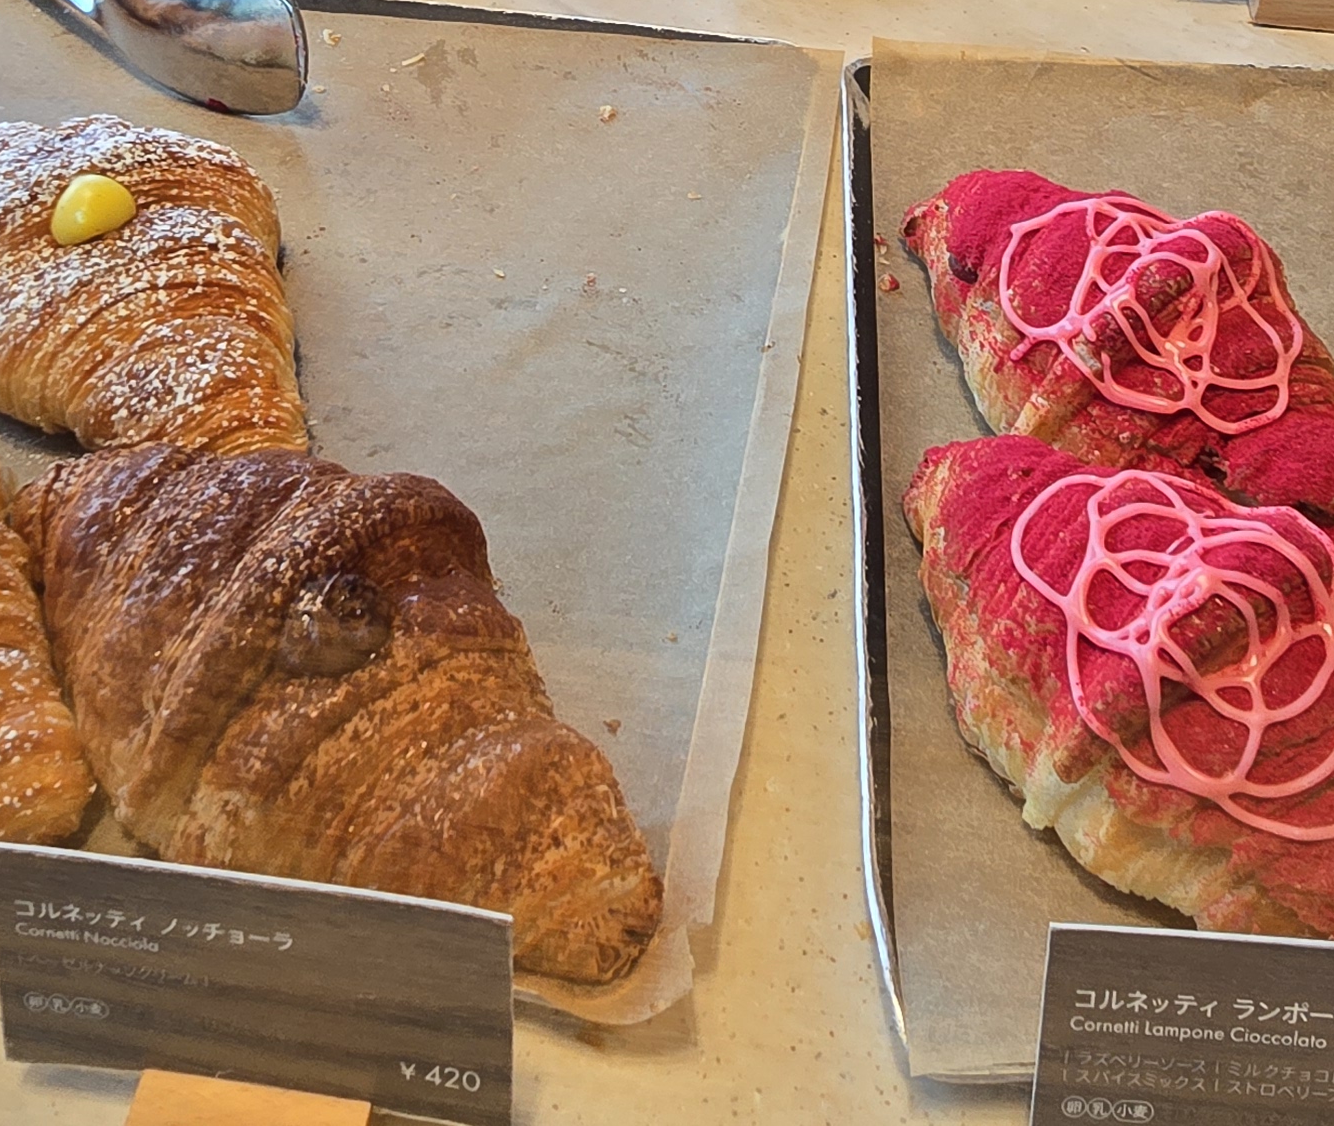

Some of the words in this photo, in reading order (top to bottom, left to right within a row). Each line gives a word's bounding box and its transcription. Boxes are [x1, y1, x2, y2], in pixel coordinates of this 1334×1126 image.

[15, 899, 147, 933] コルネッティ
[161, 919, 295, 952] ノッチョーラ
[15, 921, 81, 945] Cornetti
[83, 929, 160, 953] Nocciola
[1074, 988, 1219, 1020] コルネッティ
[1069, 1015, 1140, 1037] Cornetti
[1144, 1019, 1225, 1043] Lampone
[1230, 1027, 1328, 1050] Cioccolato
[400, 1061, 481, 1093] ¥420
[1078, 1049, 1207, 1073] ラズベリーソース
